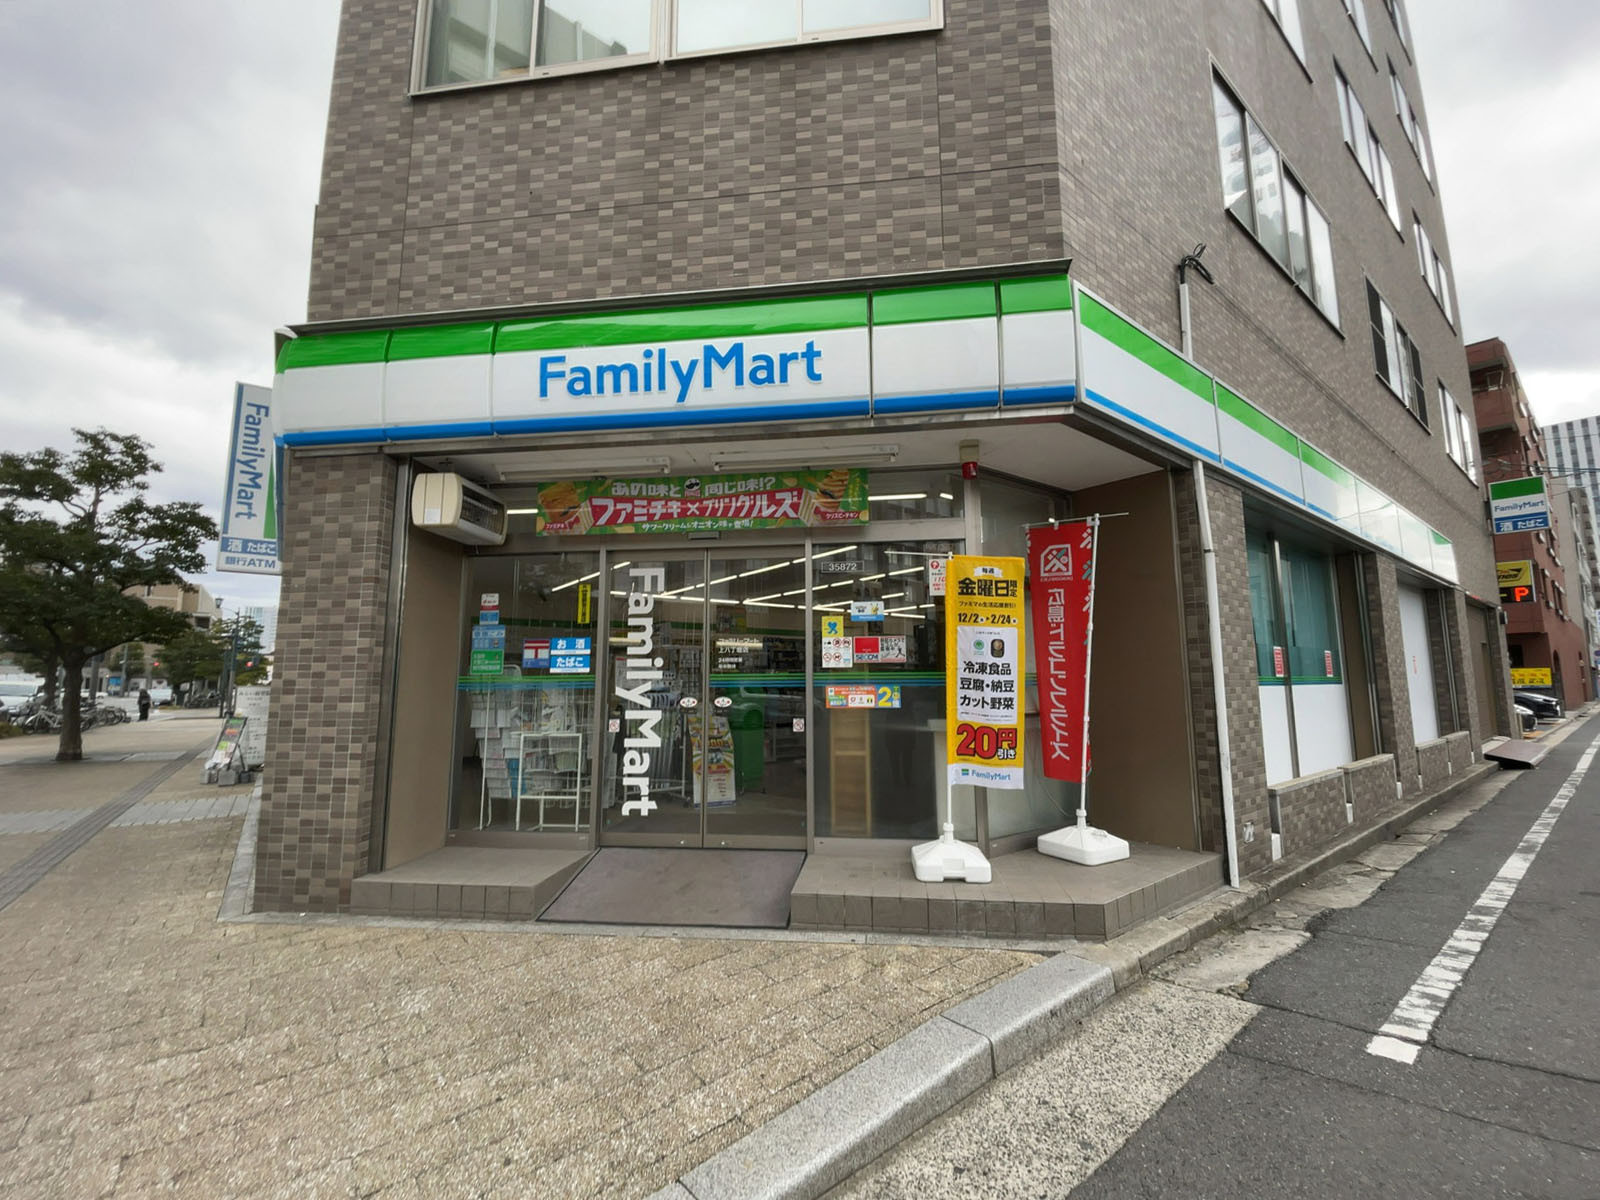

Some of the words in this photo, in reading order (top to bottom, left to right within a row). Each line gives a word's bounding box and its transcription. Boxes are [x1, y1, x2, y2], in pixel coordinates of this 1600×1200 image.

[539, 339, 822, 404] FamilyMart
[235, 401, 270, 519] FamilyMart
[611, 482, 681, 497] あの味と
[1494, 499, 1545, 513] FamilyMart
[1500, 521, 1513, 532] 酒
[1517, 517, 1545, 529] たばこ
[227, 539, 242, 552] 酒
[247, 541, 276, 554] たばこ
[224, 556, 277, 569] 銀行ATM
[828, 562, 857, 572] 35872
[958, 577, 1009, 597] 金曜日
[1514, 586, 1529, 602] P
[958, 612, 980, 623] 12/2
[990, 614, 1012, 624] 2/24
[557, 639, 567, 649] お
[575, 639, 586, 649] 酒
[556, 656, 584, 667] たばこ
[963, 660, 1012, 676] 冷凍食品
[615, 567, 665, 817] FamilyMart
[960, 677, 1015, 693] 豆腐・納豆
[877, 686, 893, 707] 2
[960, 694, 1015, 710] カット野菜
[956, 723, 997, 759] 20
[997, 728, 1018, 749] 円
[997, 748, 1016, 760] 引き
[971, 769, 1011, 781] FamilyMart
